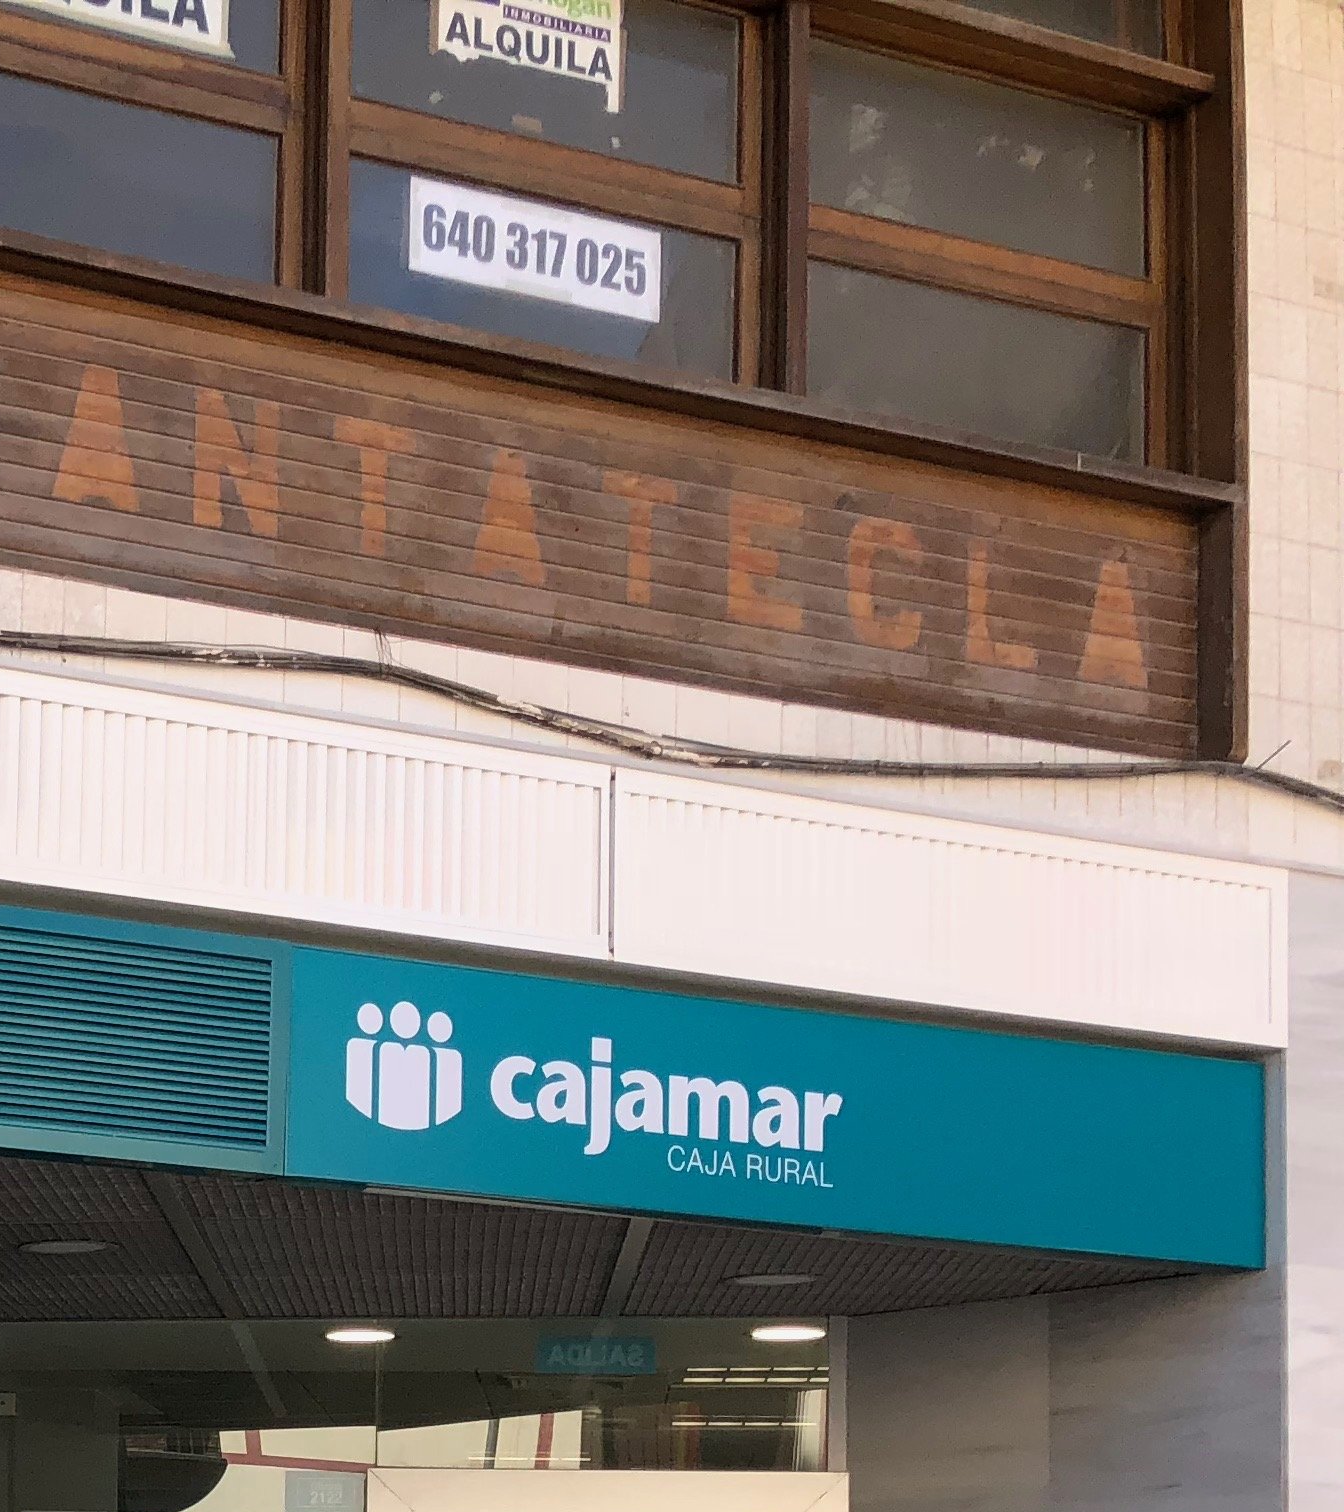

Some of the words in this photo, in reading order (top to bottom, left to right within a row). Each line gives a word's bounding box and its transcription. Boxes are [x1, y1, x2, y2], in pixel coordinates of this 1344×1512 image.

[445, 12, 612, 80] ALQUILA
[505, 5, 610, 41] INMOBILIARIA
[423, 204, 496, 264] 640
[506, 222, 568, 278] 317
[576, 238, 646, 297] 025
[490, 1037, 843, 1155] cajamar
[667, 1145, 736, 1177] CAJA
[746, 1154, 833, 1188] RURAL
